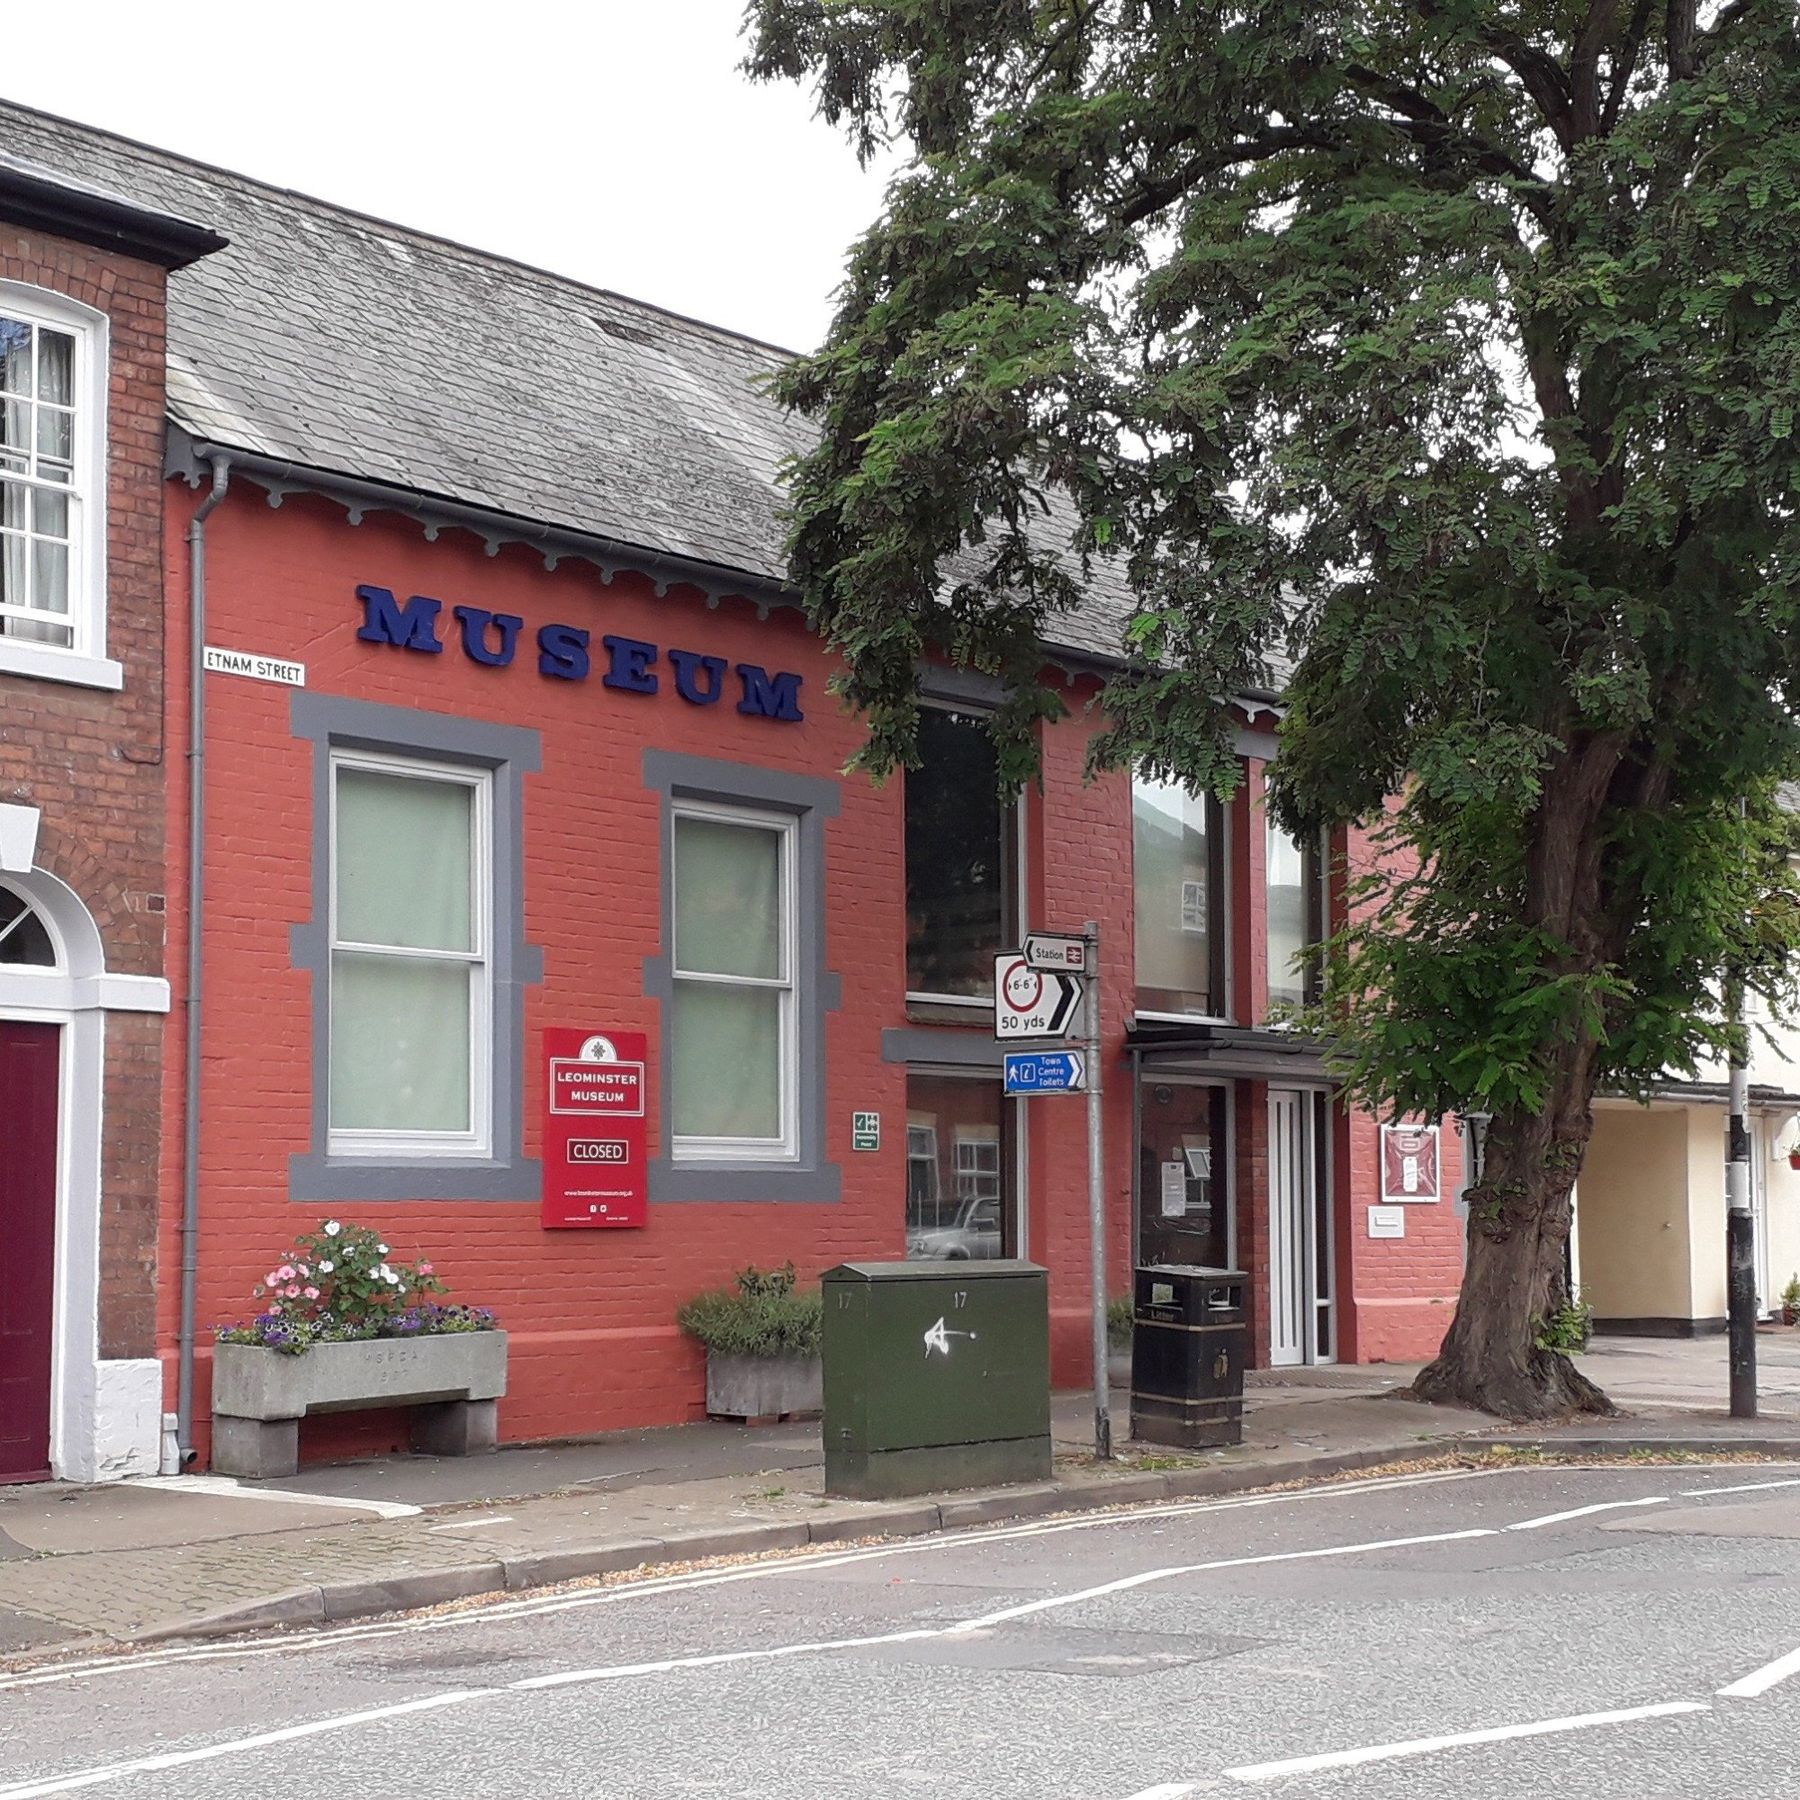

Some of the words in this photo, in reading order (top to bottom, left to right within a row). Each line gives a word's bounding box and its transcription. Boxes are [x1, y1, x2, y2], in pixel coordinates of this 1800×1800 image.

[356, 584, 804, 721] MUSEUM
[207, 651, 252, 673] ETNAM
[256, 661, 301, 682] STREET
[1036, 947, 1064, 960] Station
[1001, 1016, 1018, 1029] 50
[1023, 1015, 1045, 1031] yds
[1041, 1056, 1061, 1065] Town
[557, 1071, 637, 1085] LEOMINSTER
[1038, 1067, 1065, 1076] Centre
[1039, 1077, 1065, 1087] Toilets
[571, 1090, 624, 1102] MUSEUM
[573, 1144, 623, 1159] CLOSED
[839, 1292, 852, 1309] 17
[954, 1291, 967, 1309] 17
